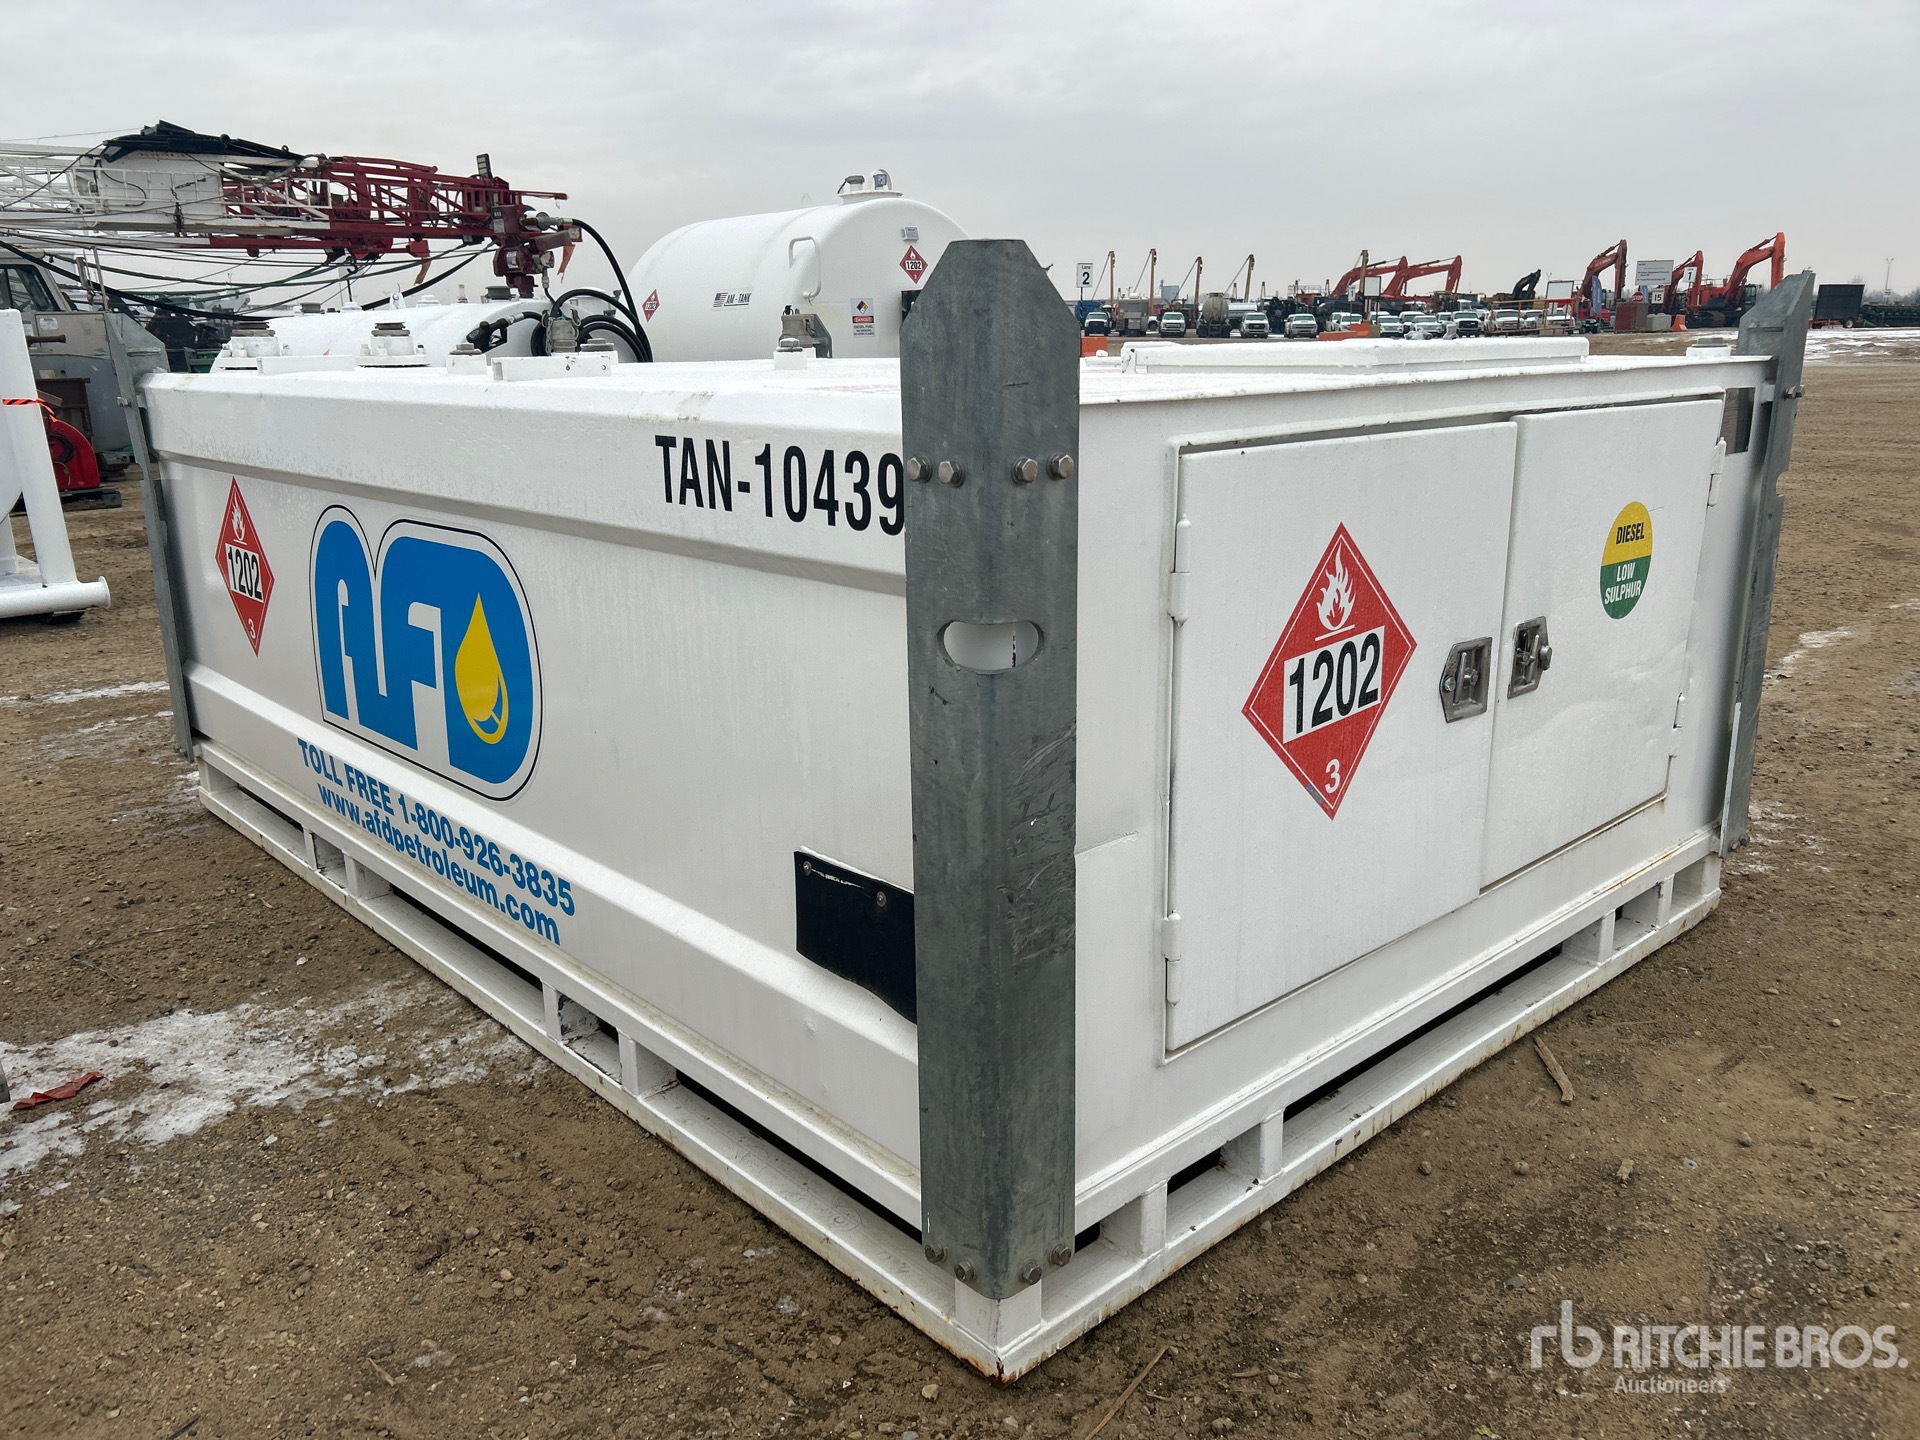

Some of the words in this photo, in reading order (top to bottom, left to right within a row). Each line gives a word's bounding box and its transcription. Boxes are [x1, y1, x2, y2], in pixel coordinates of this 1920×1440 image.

[906, 261, 922, 270] 1202
[1688, 271, 1692, 281] 1
[1082, 271, 1090, 285] 2
[726, 294, 735, 304] AM
[1654, 294, 1662, 302] 15
[655, 434, 905, 536] TAN-10439
[1615, 521, 1646, 545] DIESEL
[226, 545, 264, 602] 1202
[1616, 562, 1636, 583] LOW
[1604, 580, 1642, 605] SULPHUR
[247, 617, 257, 640] 3
[1289, 631, 1381, 735] 1202
[1325, 758, 1341, 794] 3
[298, 738, 343, 787] TOLL
[346, 764, 395, 816] FREE
[398, 795, 576, 917] 1-800-926-3835
[318, 783, 560, 946] www.afdpetroleum.com
